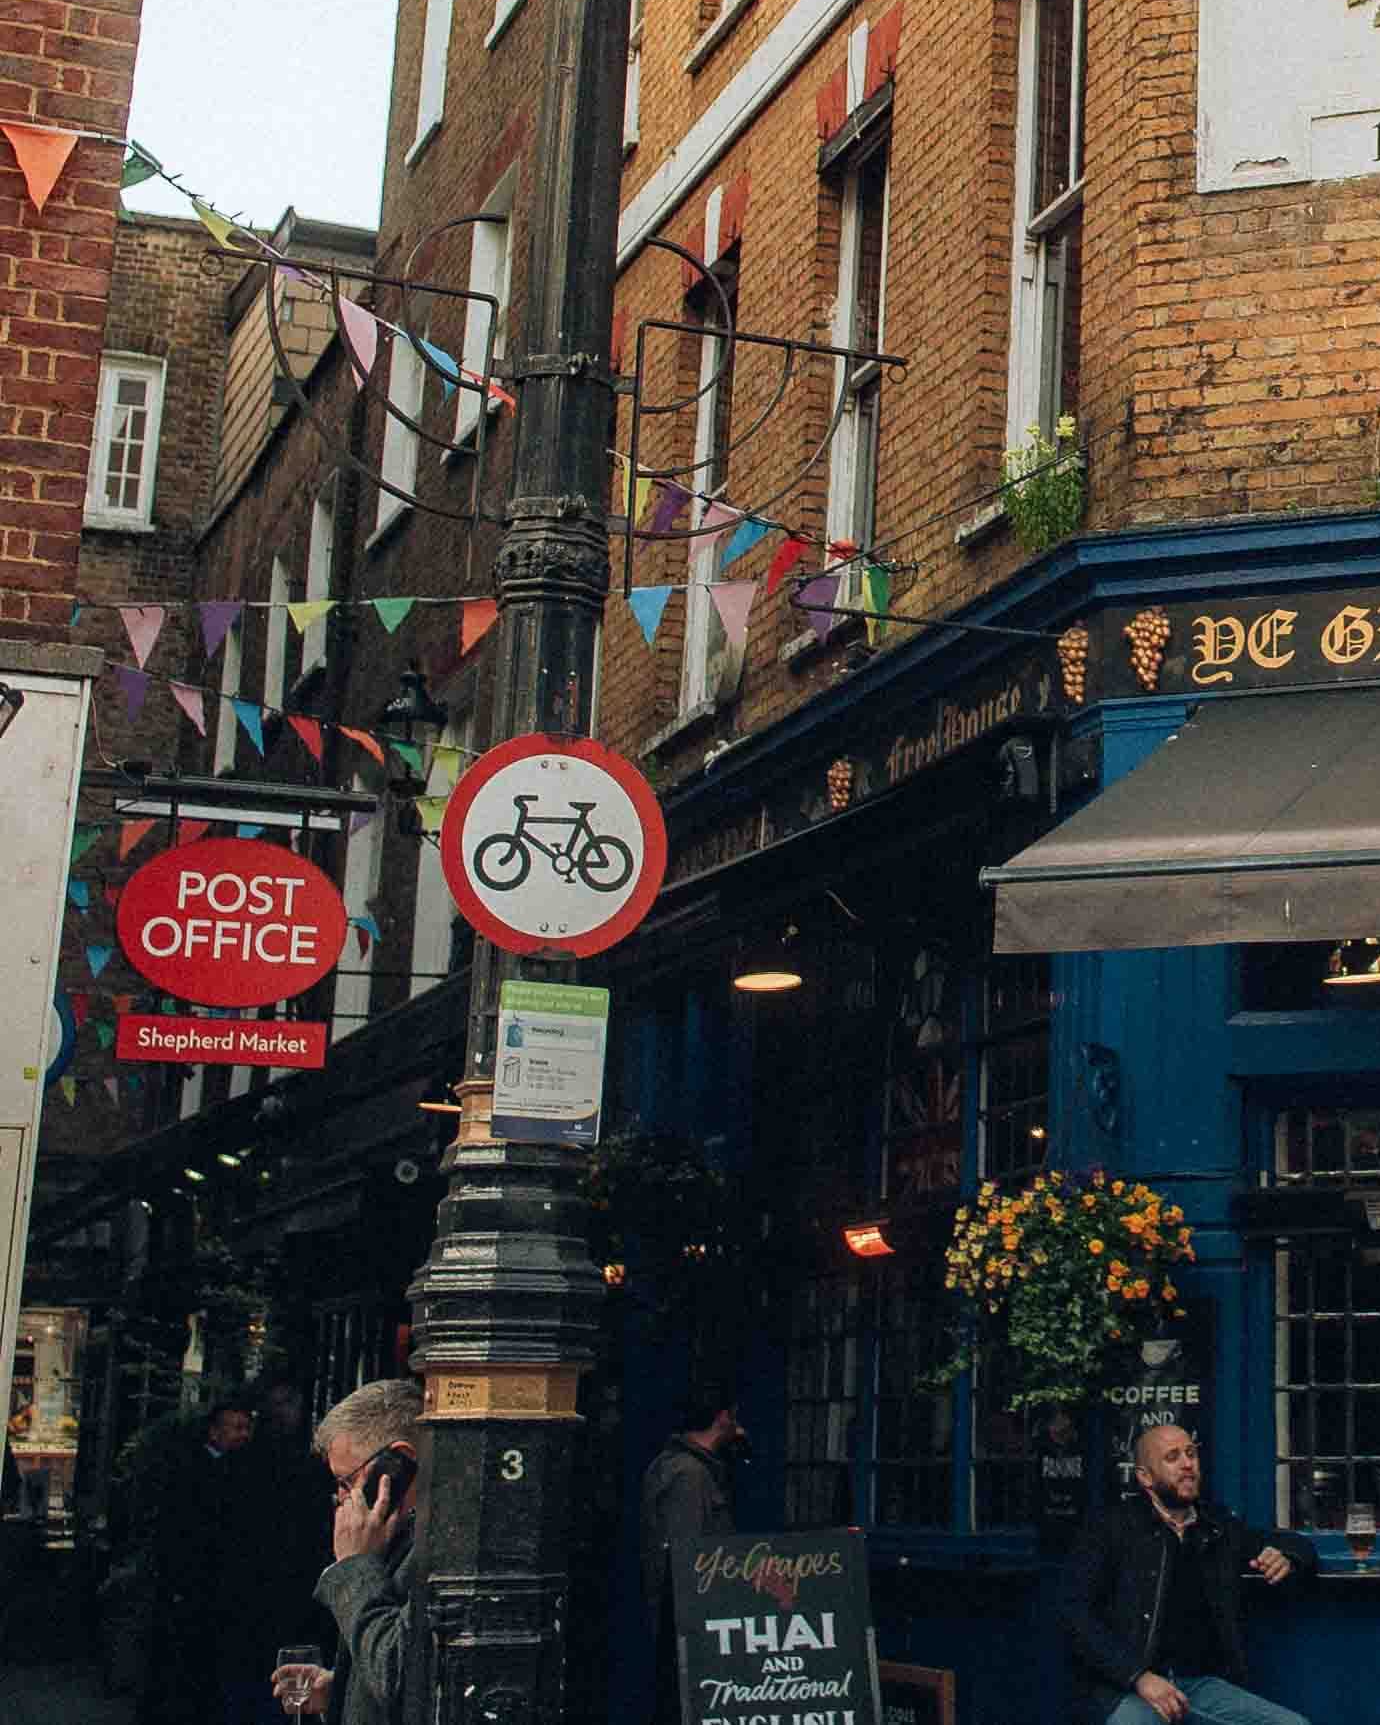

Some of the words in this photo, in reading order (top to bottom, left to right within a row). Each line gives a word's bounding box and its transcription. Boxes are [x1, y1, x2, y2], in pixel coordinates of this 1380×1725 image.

[176, 869, 305, 917] POST
[141, 915, 318, 965] OFFICE
[138, 1026, 234, 1054] Shepherd
[239, 1032, 308, 1055] Market
[1110, 1384, 1200, 1404] COFFEE
[1140, 1410, 1176, 1426] AND
[501, 1449, 525, 1481] 3
[704, 1611, 838, 1656] THAI
[760, 1655, 805, 1674] AND
[699, 1669, 854, 1710] Traditional
